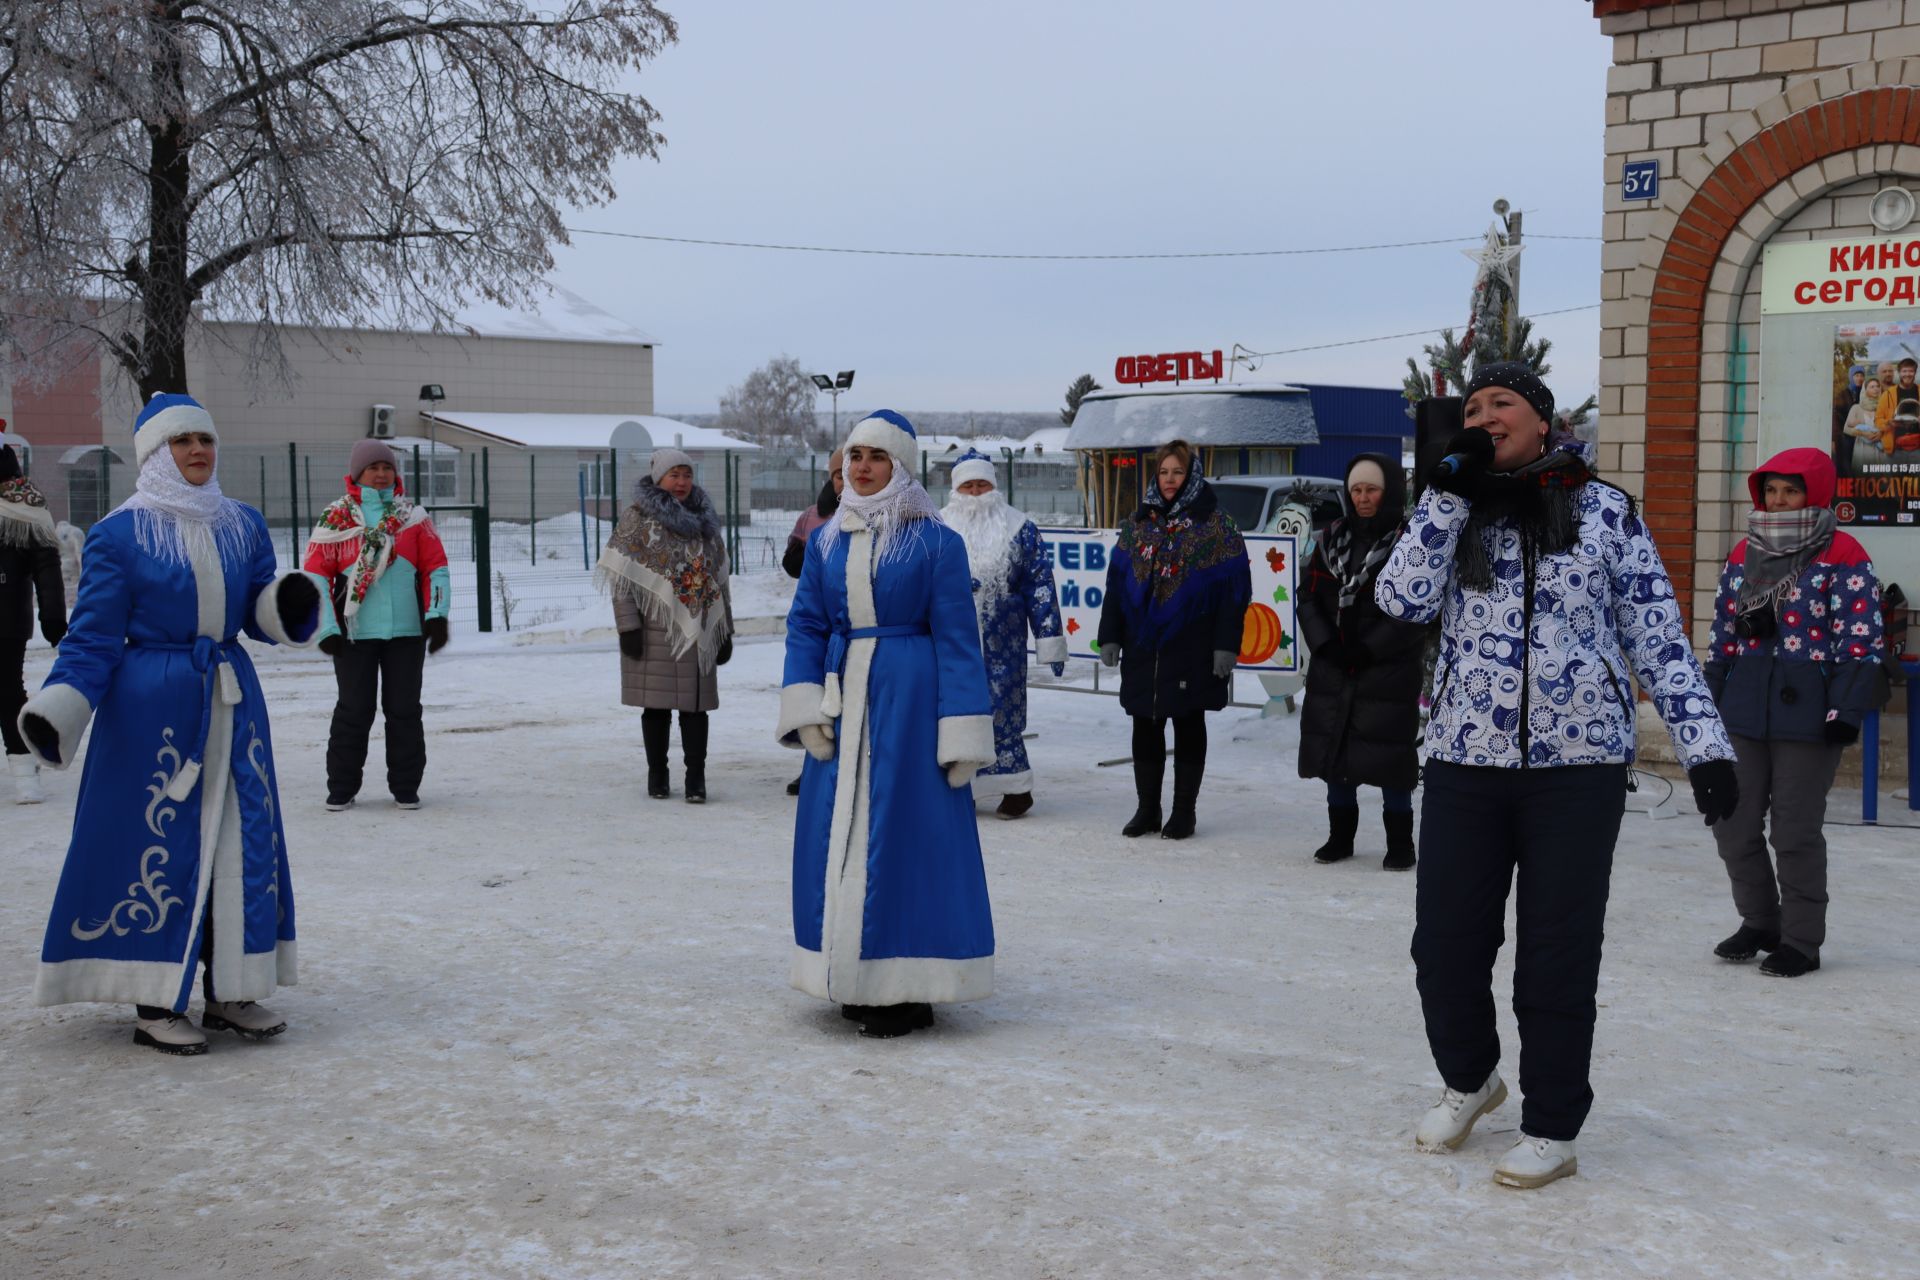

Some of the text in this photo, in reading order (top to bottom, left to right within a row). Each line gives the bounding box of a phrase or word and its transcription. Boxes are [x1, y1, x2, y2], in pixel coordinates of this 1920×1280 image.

[1625, 170, 1653, 192] 57
[1829, 241, 1920, 272] КИНО
[1794, 276, 1920, 306] сегод
[1115, 350, 1223, 384] ЦВЕТЫ
[1869, 464, 1891, 473] КИНО
[1841, 506, 1855, 518] 6+
